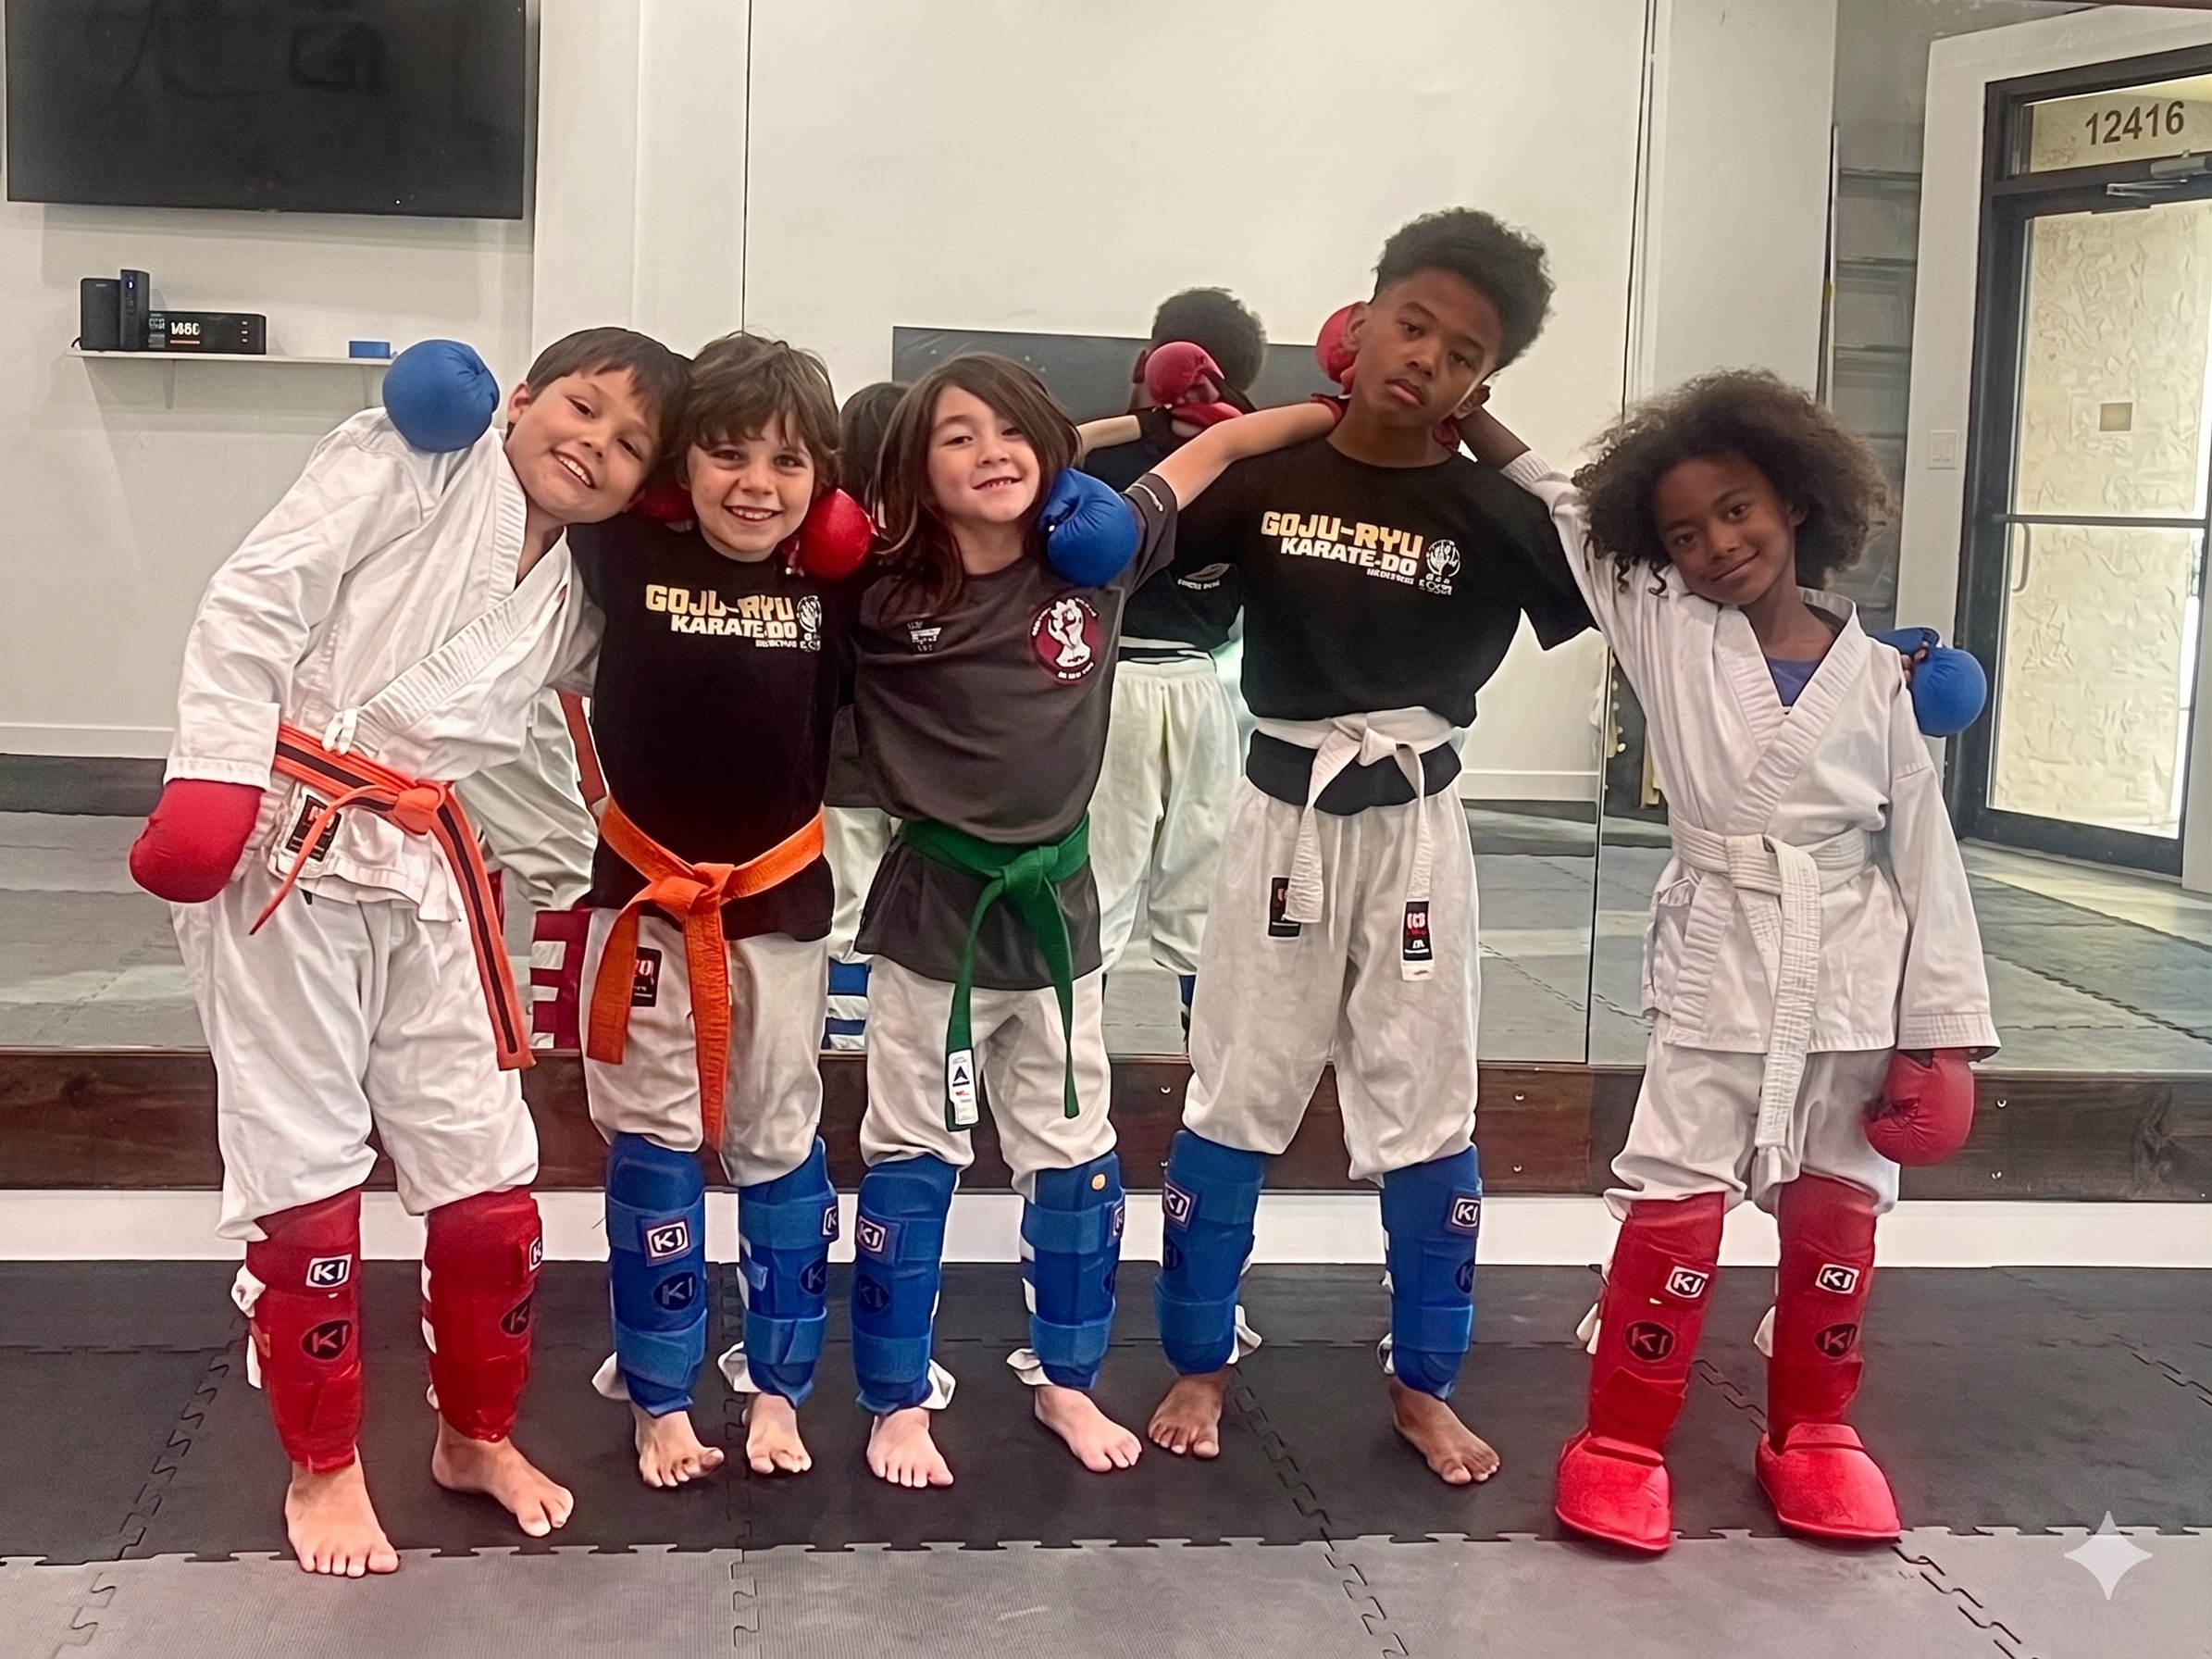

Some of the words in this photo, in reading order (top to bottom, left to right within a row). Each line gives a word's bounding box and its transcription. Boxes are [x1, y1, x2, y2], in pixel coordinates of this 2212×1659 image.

[2085, 100, 2184, 145] 12416
[1261, 511, 1423, 559] GOJU-RYU
[314, 1262, 345, 1281] KI
[1673, 1274, 1702, 1293] KI
[663, 1277, 692, 1305] KI
[313, 1325, 347, 1353] KI
[1632, 1327, 1668, 1354] KI
